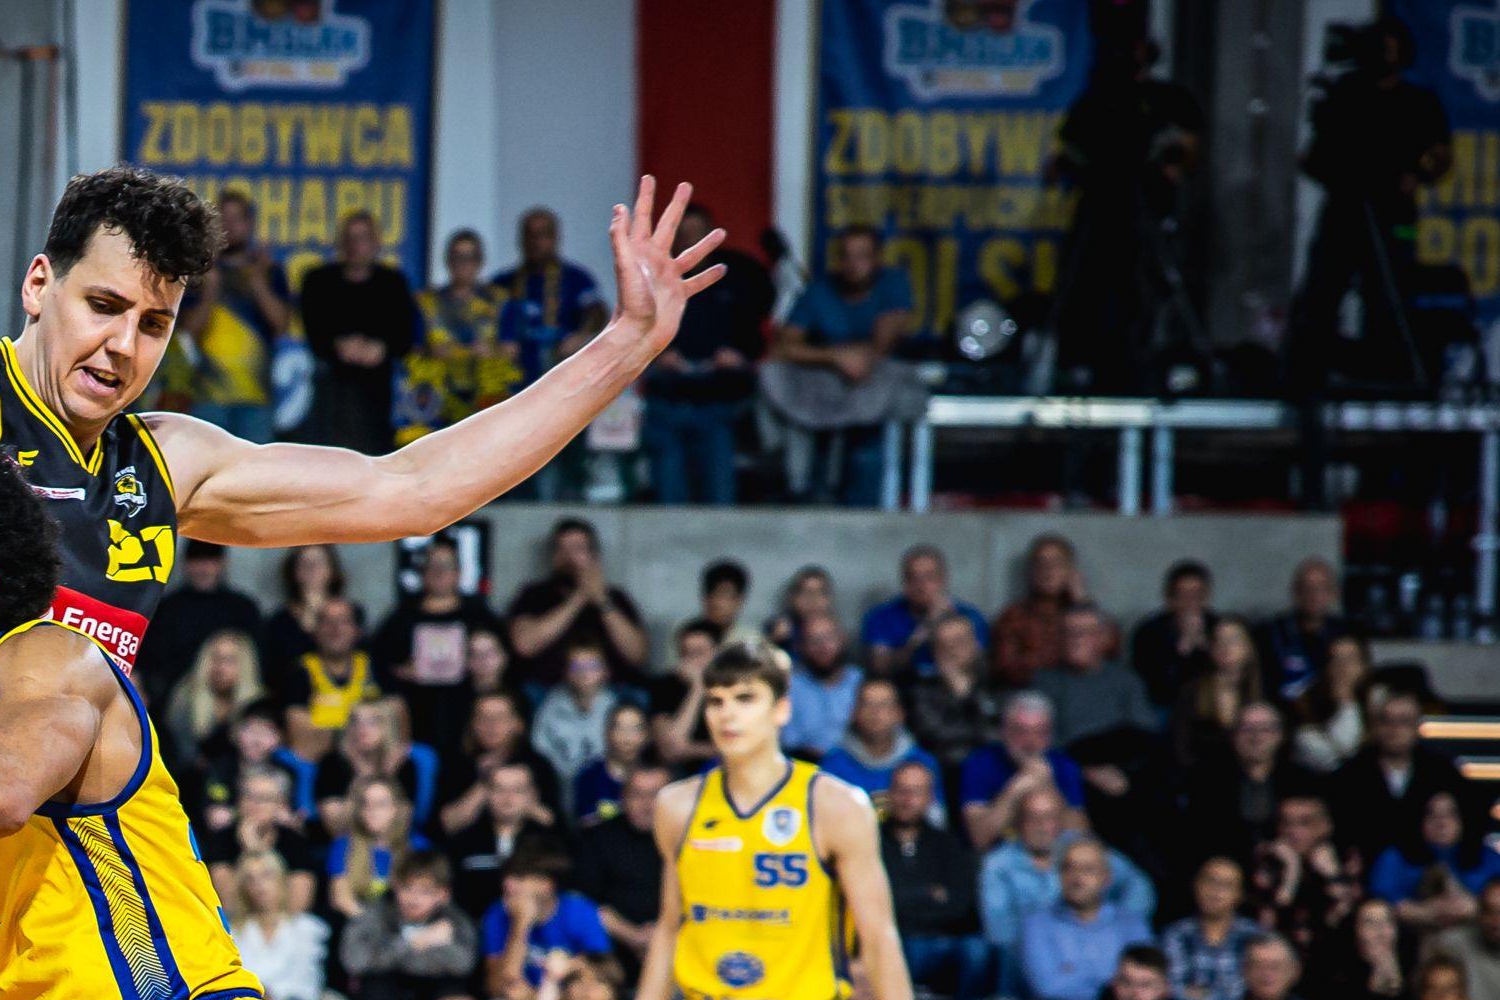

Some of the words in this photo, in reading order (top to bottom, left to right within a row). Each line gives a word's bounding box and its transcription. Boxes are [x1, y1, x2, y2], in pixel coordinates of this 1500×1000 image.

[140, 101, 414, 167] ZDOBYWCA
[62, 606, 140, 657] Energa
[754, 852, 809, 889] 55
